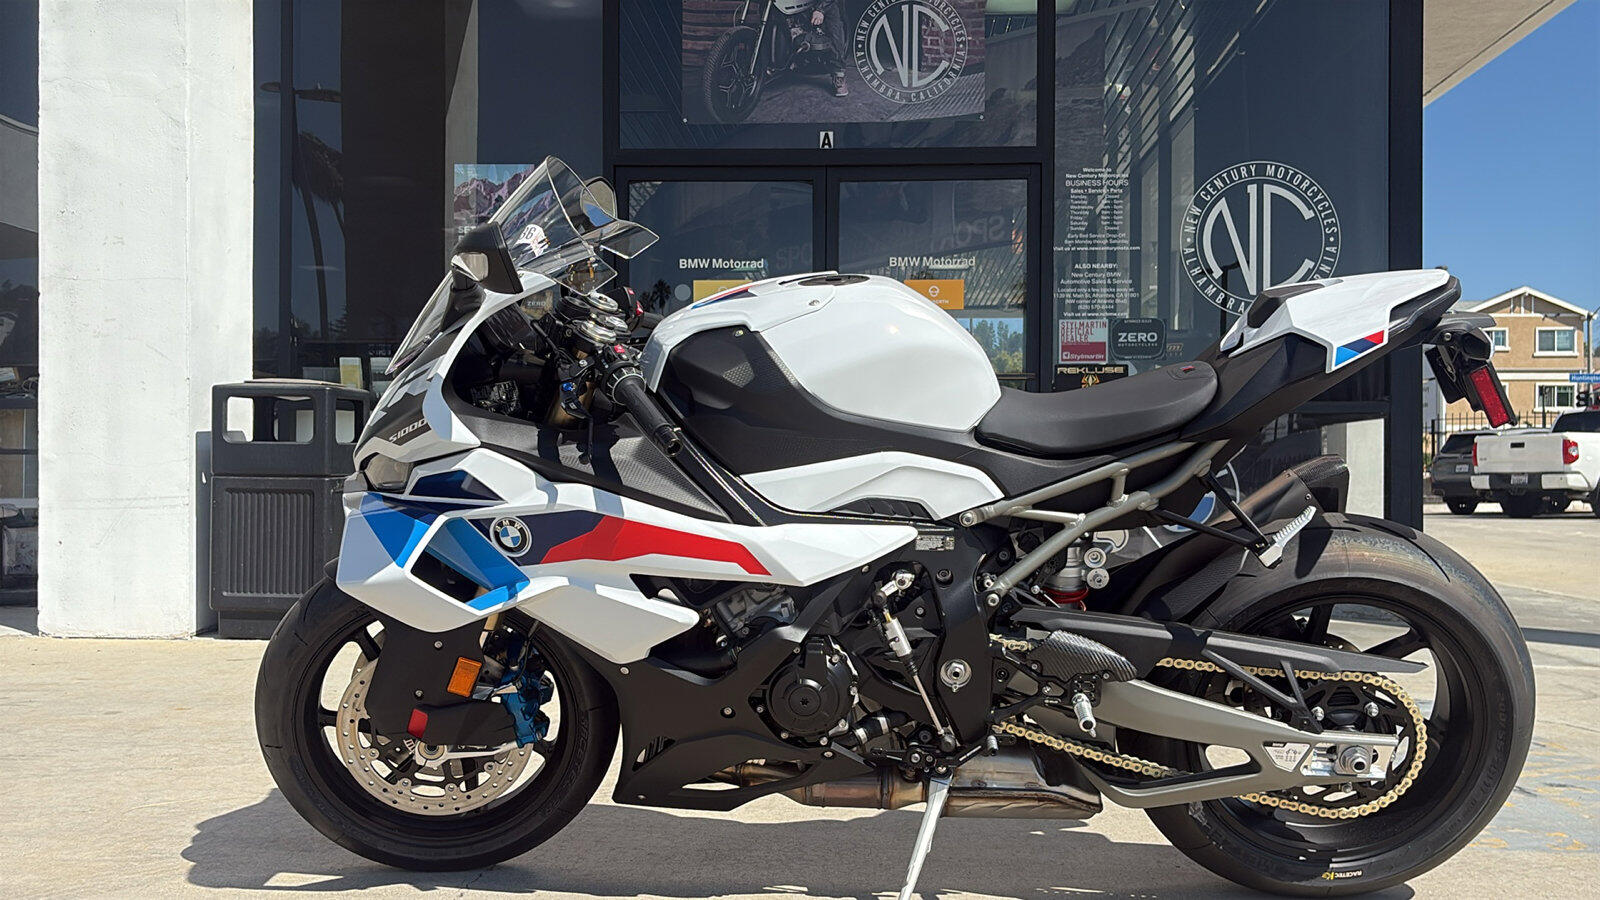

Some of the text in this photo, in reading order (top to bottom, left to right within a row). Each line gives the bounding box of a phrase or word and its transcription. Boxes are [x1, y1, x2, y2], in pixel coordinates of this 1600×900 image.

[857, 21, 870, 41] NEW
[911, 51, 966, 102] CALIFORNIA
[821, 132, 832, 149] A
[1184, 164, 1338, 235] NEW CENTURY MOTORCYCLES
[679, 258, 764, 269] BMW Motorrad
[889, 256, 976, 267] BMW Motorrad
[1060, 320, 1107, 328] STYLMARTIN
[1117, 332, 1158, 343] ZERO
[1057, 366, 1124, 375] REKLUSE
[388, 418, 427, 443] S1000
[495, 519, 522, 533] BMW
